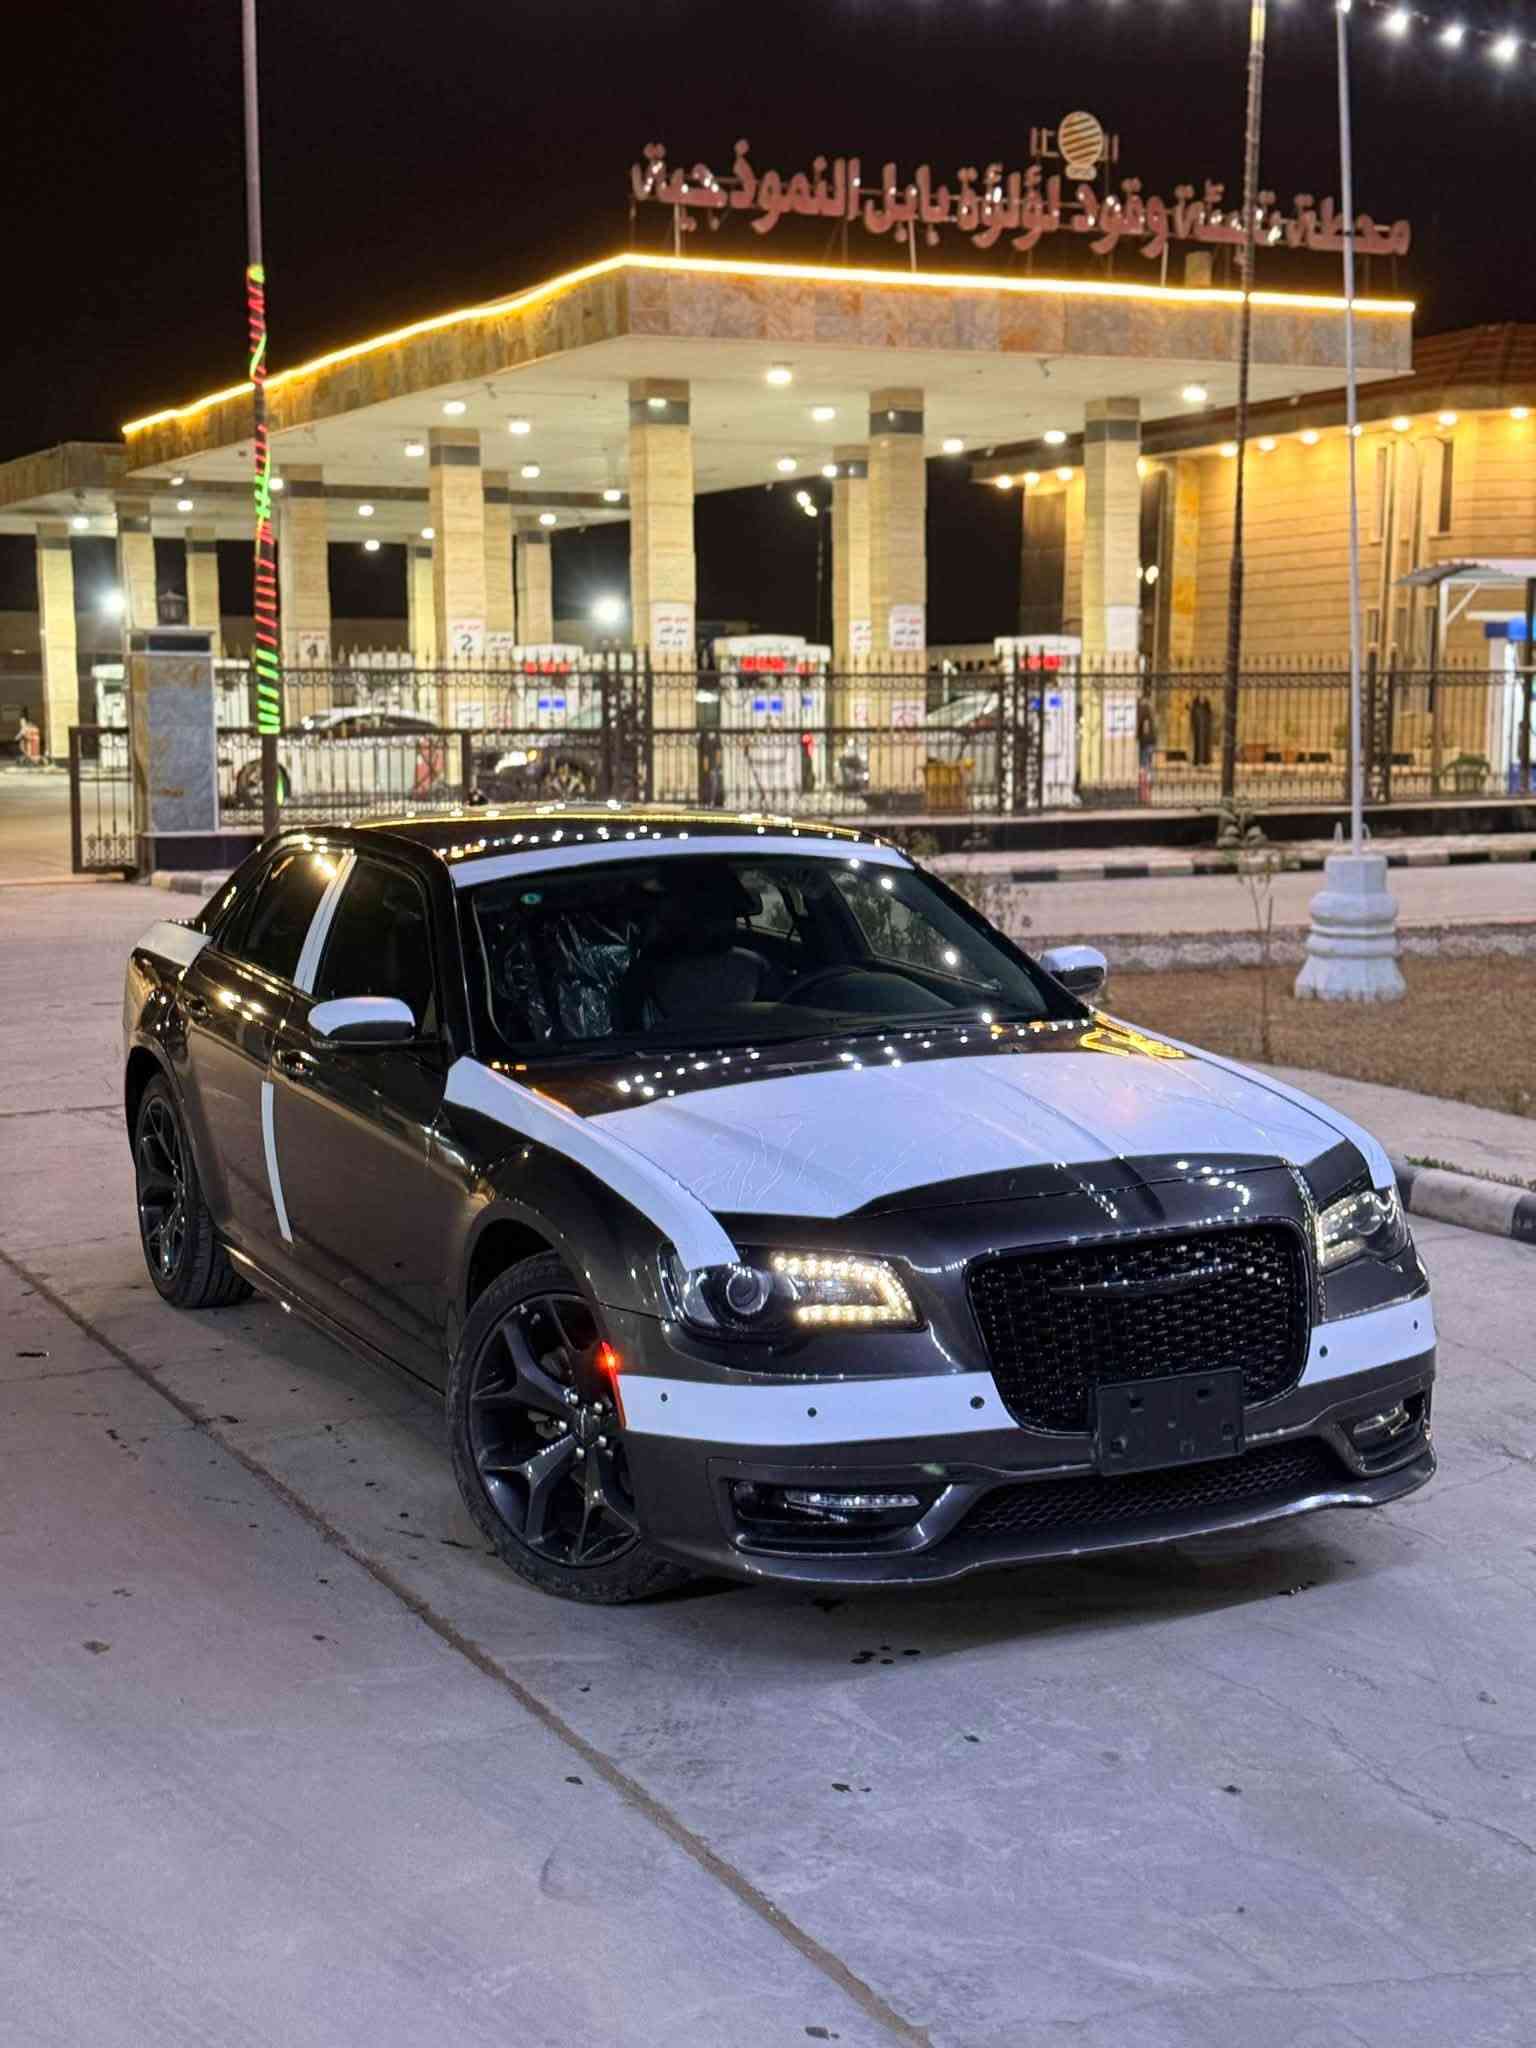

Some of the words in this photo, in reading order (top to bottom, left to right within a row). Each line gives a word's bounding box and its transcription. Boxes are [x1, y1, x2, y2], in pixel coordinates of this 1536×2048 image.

[631, 139, 861, 235] النموذجية
[864, 162, 950, 248] بابل
[955, 163, 1061, 251] لؤلؤة
[1072, 177, 1168, 258] وقود
[1286, 194, 1411, 256] محطة
